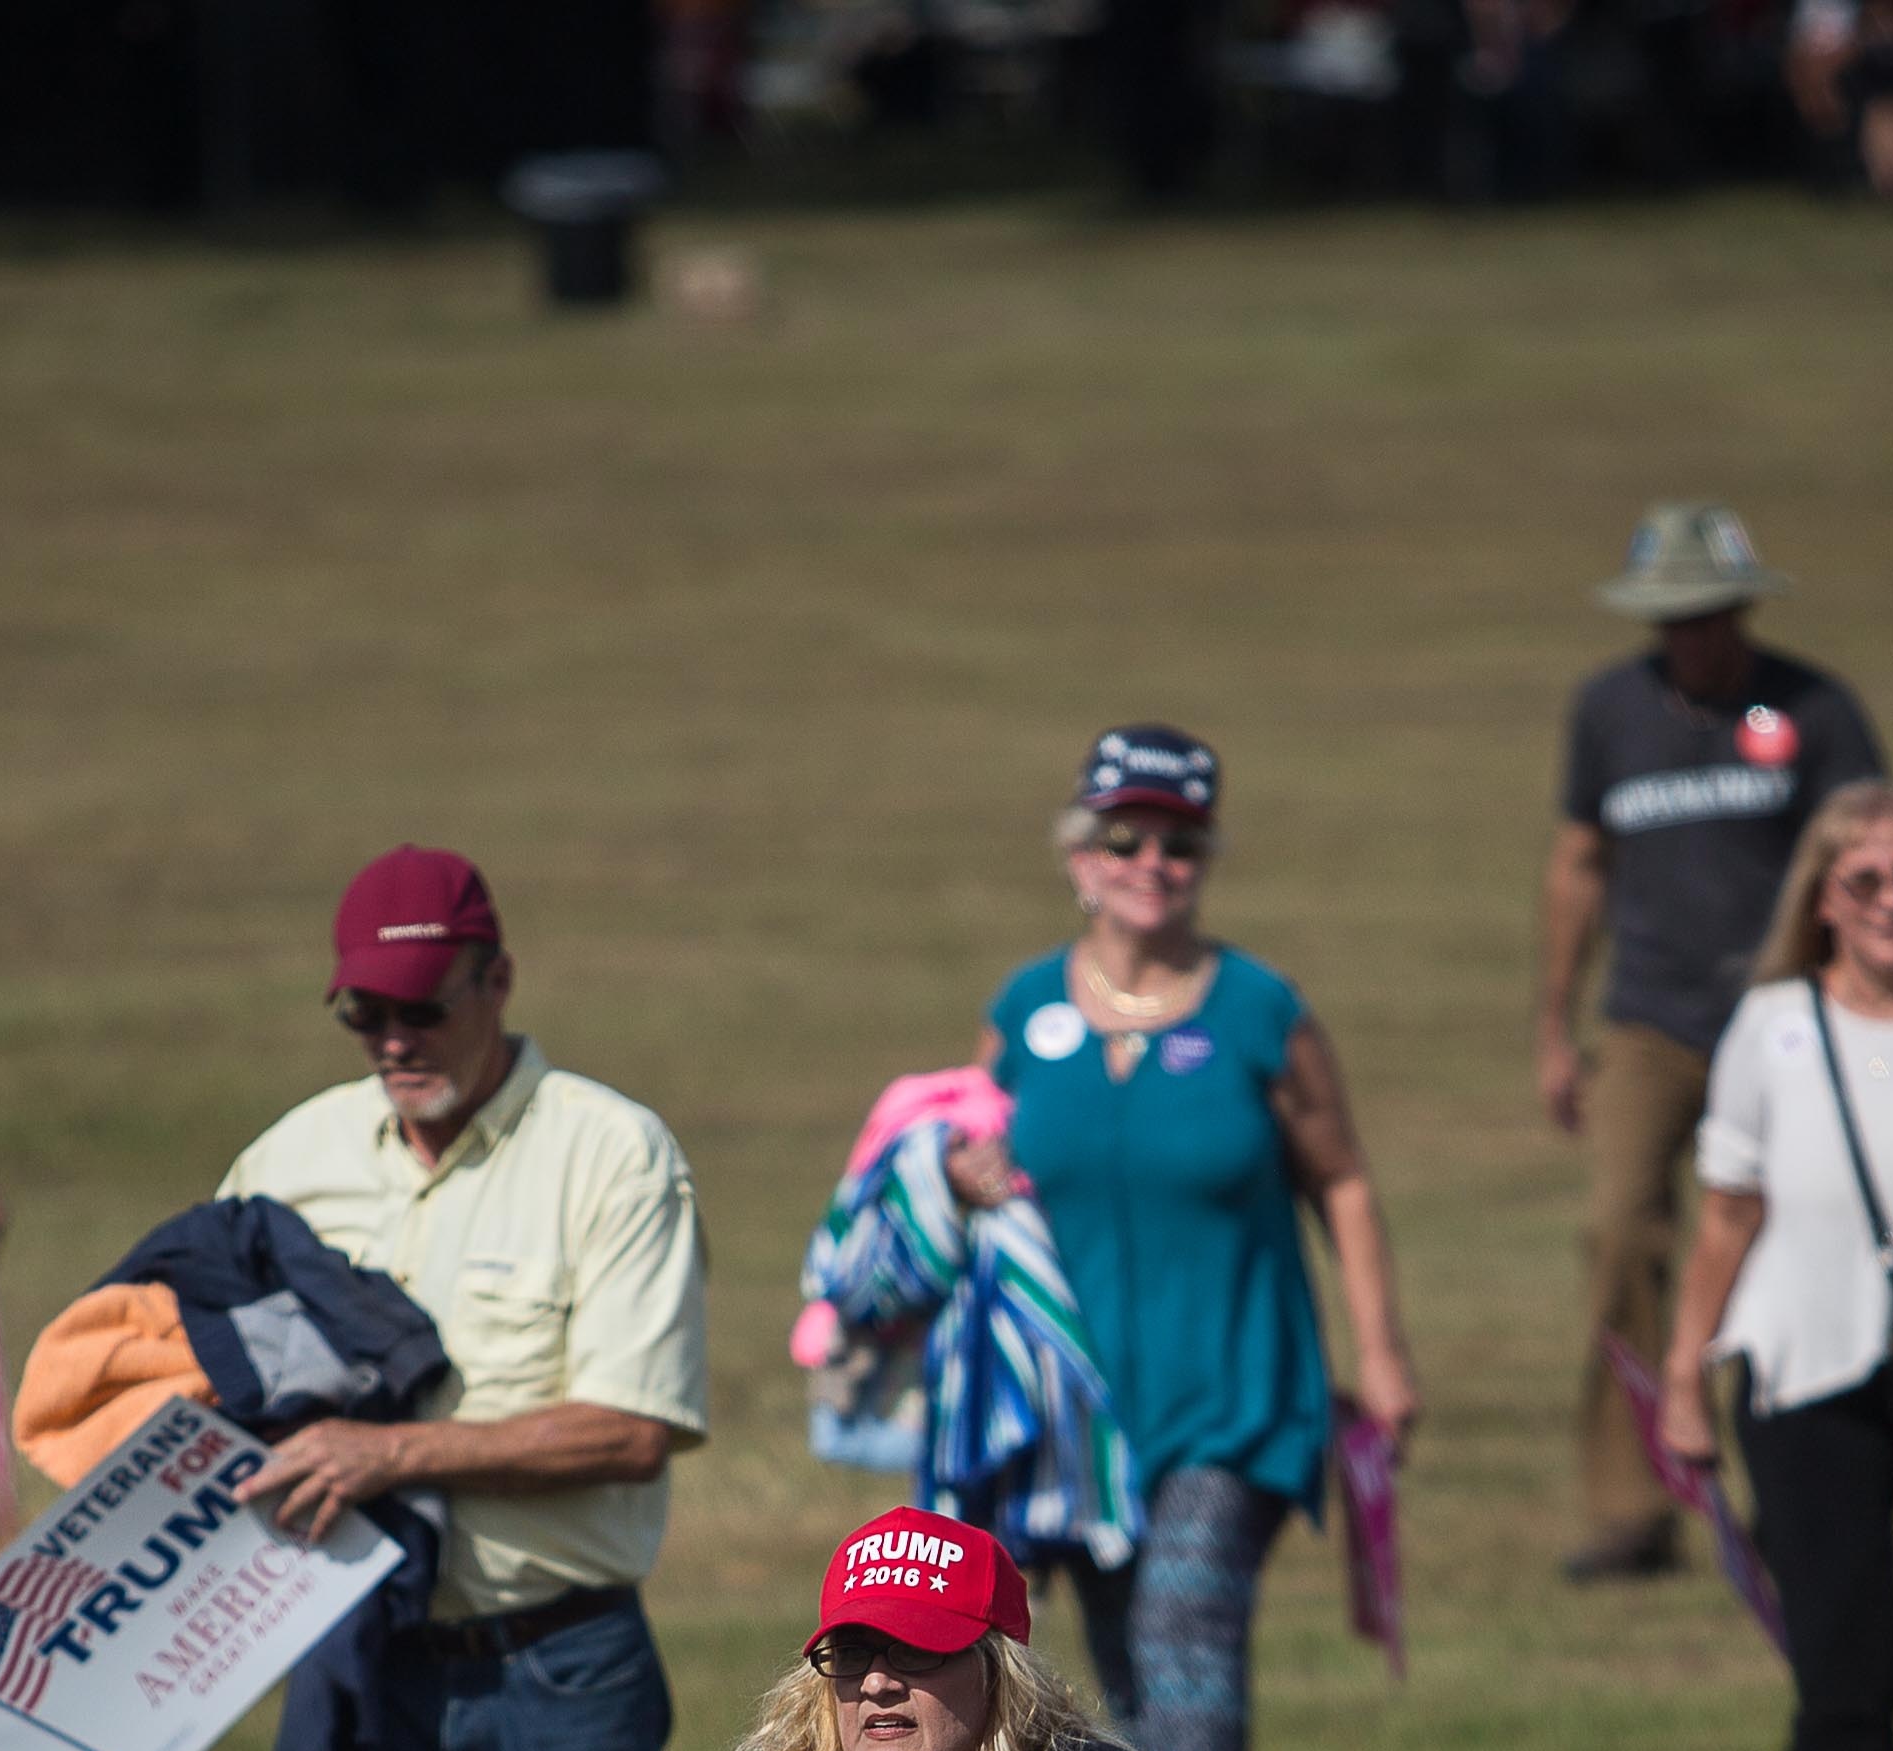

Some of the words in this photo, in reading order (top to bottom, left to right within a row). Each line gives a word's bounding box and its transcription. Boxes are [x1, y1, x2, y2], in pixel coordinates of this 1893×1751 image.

[34, 1406, 203, 1560] VETERANS
[159, 1429, 233, 1493] FOR
[38, 1449, 269, 1664] TRUMP
[845, 1531, 964, 1571] TRUMP
[861, 1566, 920, 1588] 2016
[166, 1564, 223, 1617] MAKE
[189, 1634, 250, 1696] GREAT
